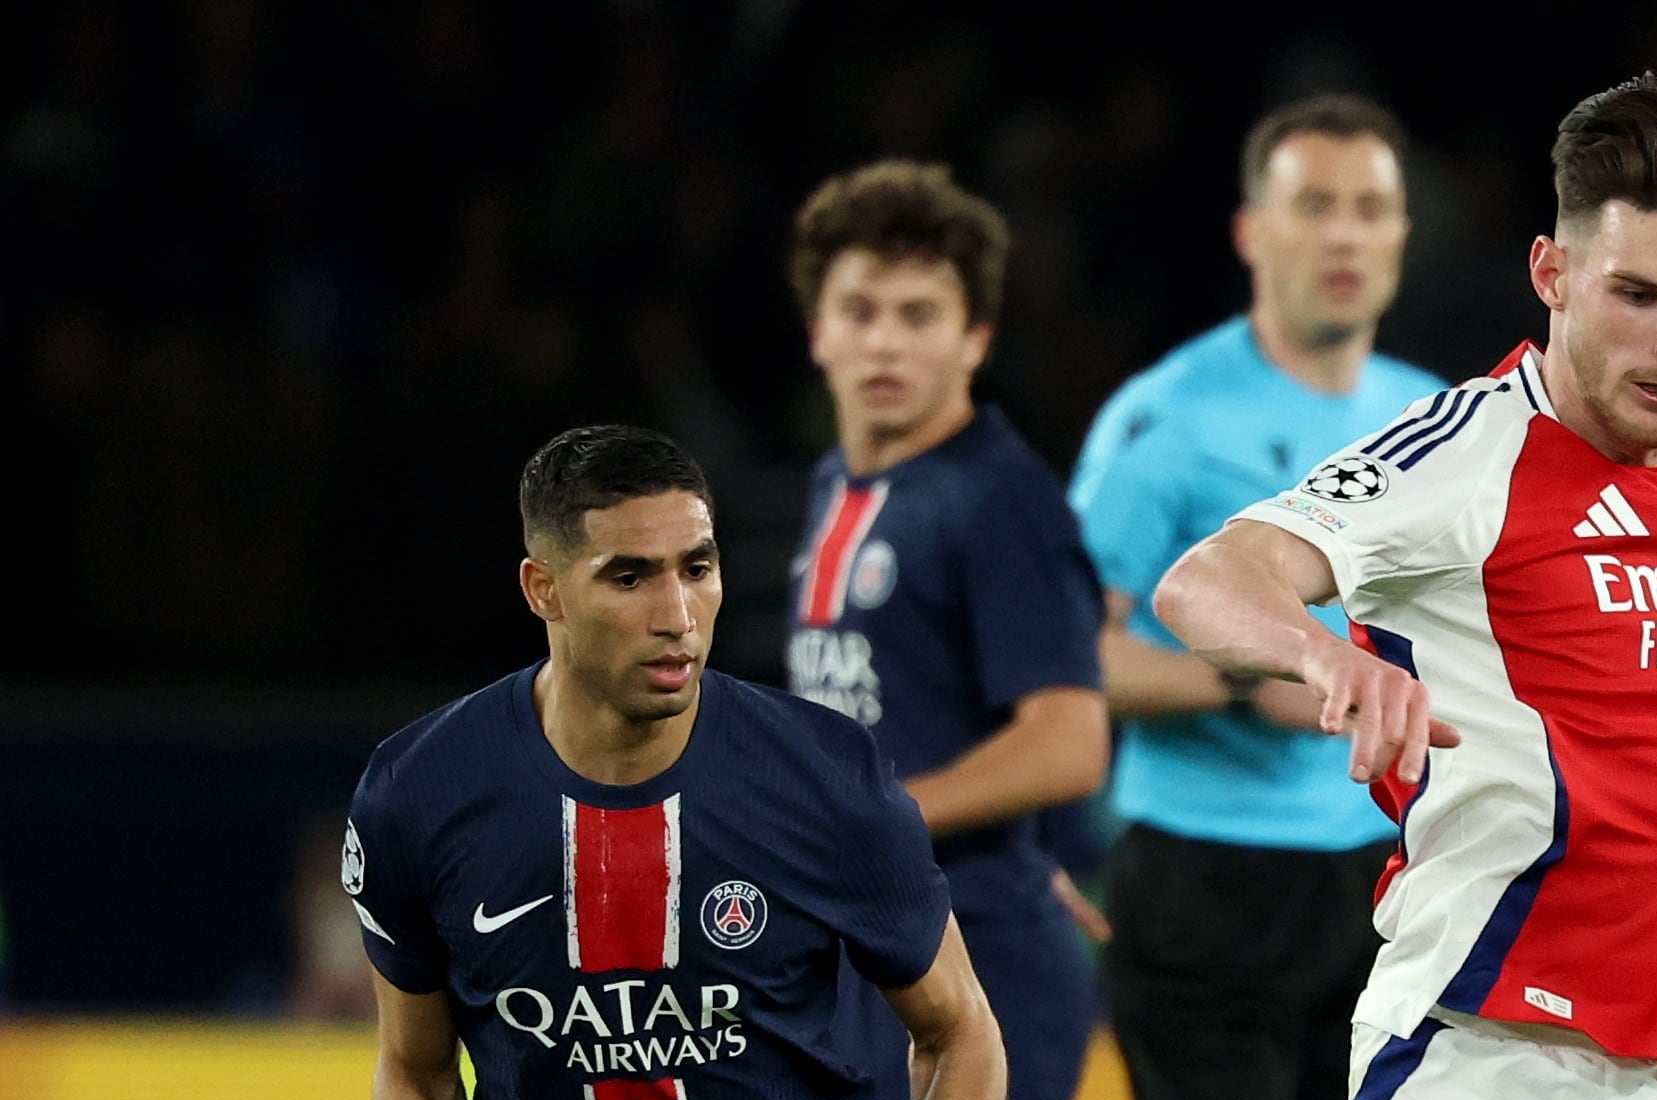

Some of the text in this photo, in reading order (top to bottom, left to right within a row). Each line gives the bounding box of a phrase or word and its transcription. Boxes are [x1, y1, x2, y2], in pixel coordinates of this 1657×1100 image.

[713, 884, 758, 901] PARIS
[495, 979, 742, 1048] QATAR
[566, 1024, 747, 1073] AIRWAYS
